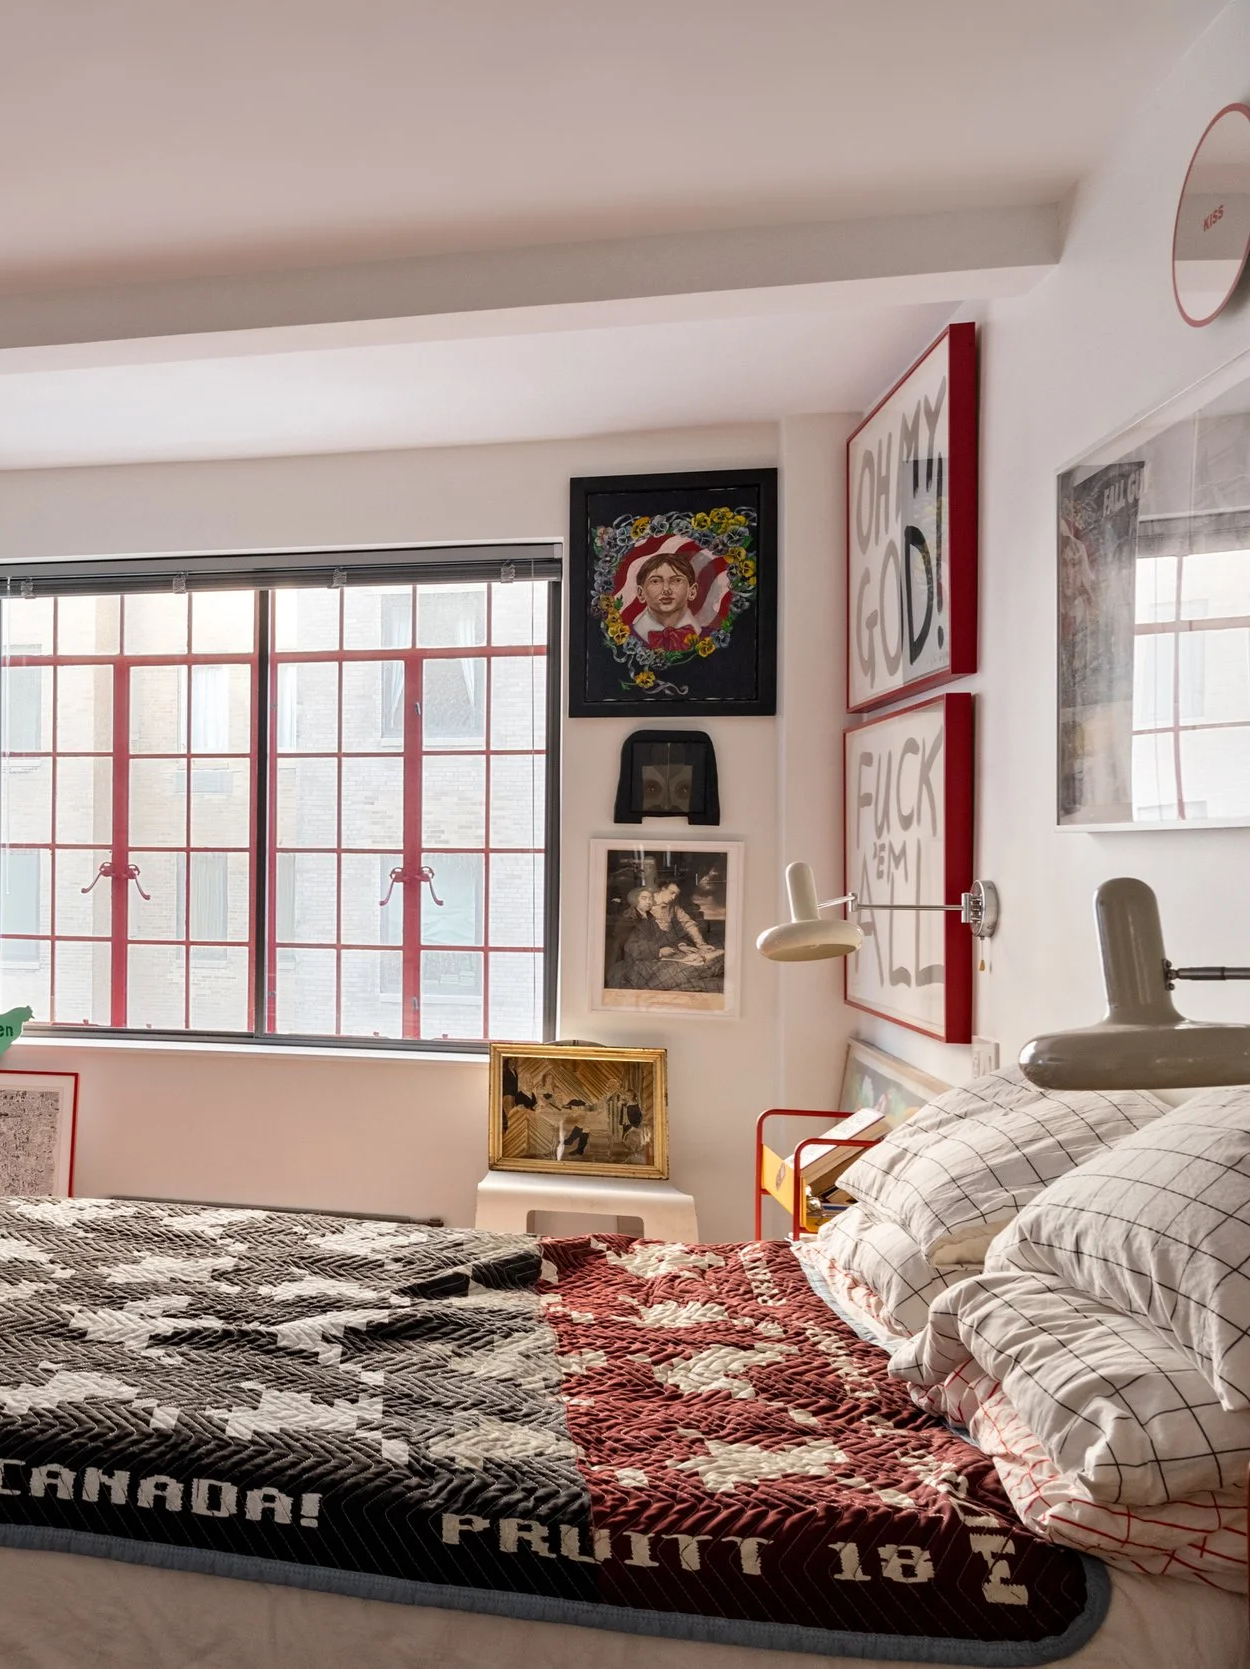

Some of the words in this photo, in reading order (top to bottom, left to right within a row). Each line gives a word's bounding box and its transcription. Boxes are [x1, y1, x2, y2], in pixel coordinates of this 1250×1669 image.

[1202, 204, 1224, 232] KISS
[856, 432, 893, 554] OH
[897, 376, 947, 523] MY
[856, 725, 944, 849] FUCK
[854, 838, 945, 988] ALL
[441, 1512, 774, 1576] PRUITT
[828, 1541, 935, 1583] 18
